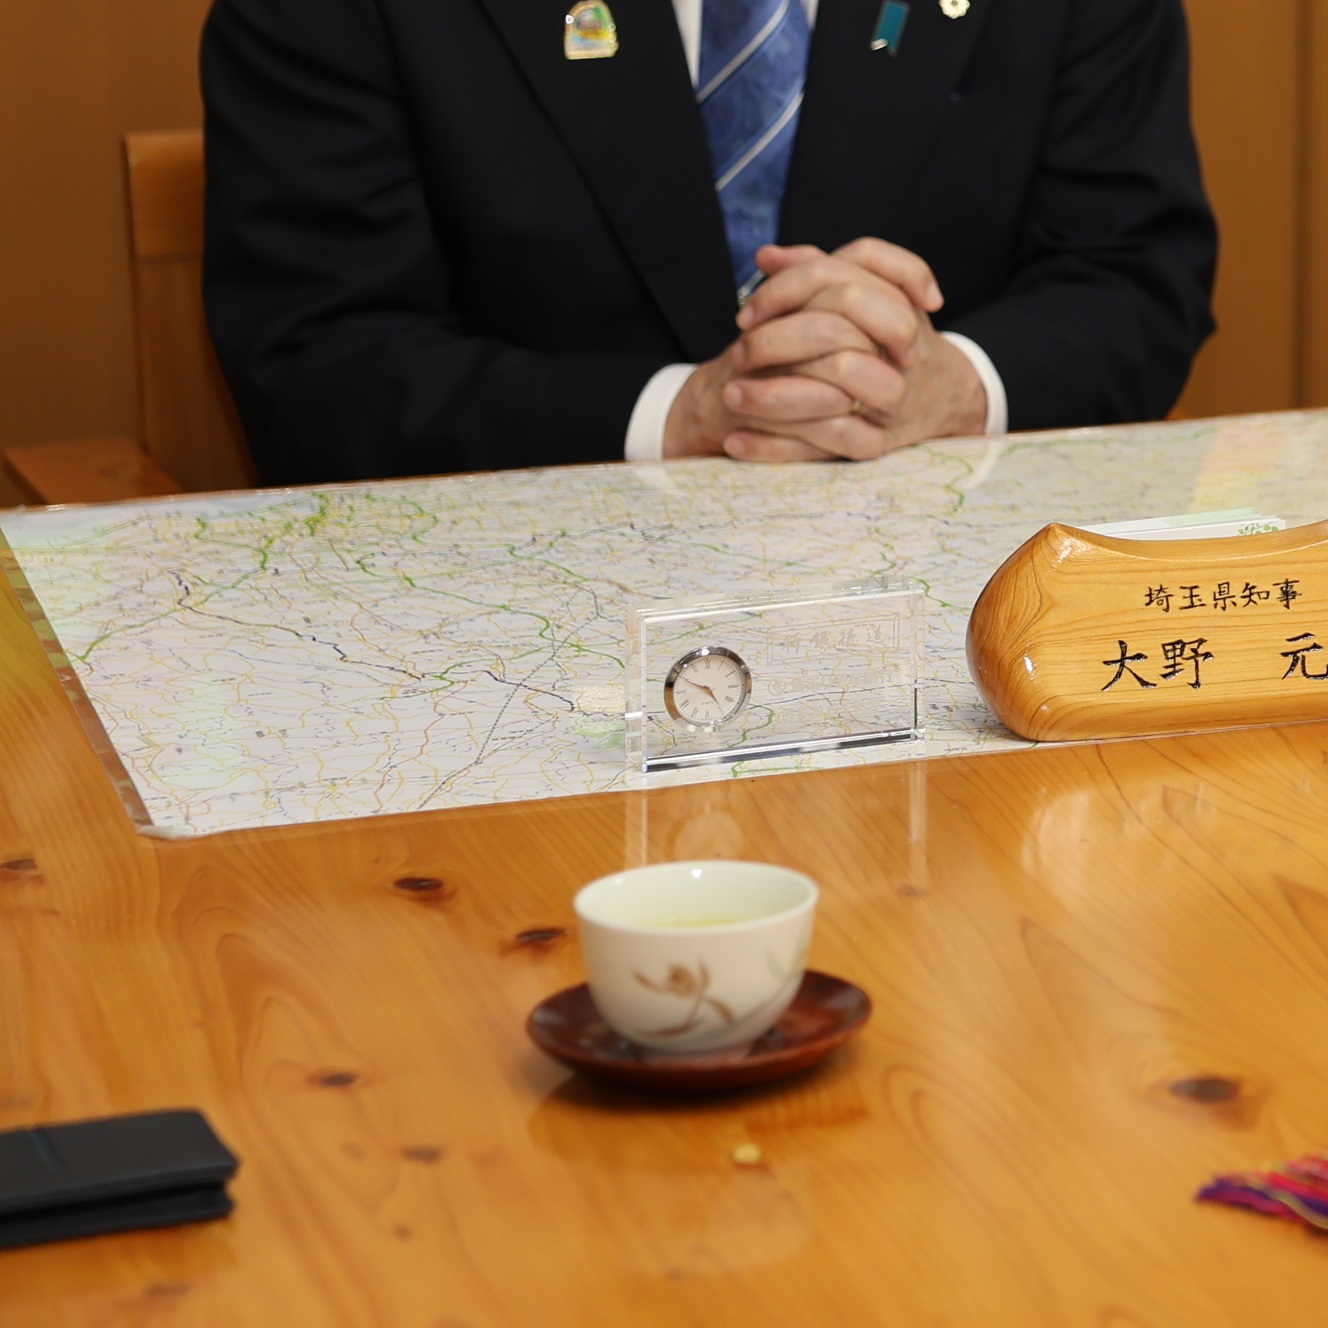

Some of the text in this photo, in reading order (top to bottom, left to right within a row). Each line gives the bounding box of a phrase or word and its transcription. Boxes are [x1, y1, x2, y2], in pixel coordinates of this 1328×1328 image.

[1144, 577, 1303, 613] 埼玉県知事
[1101, 637, 1215, 692] 大野
